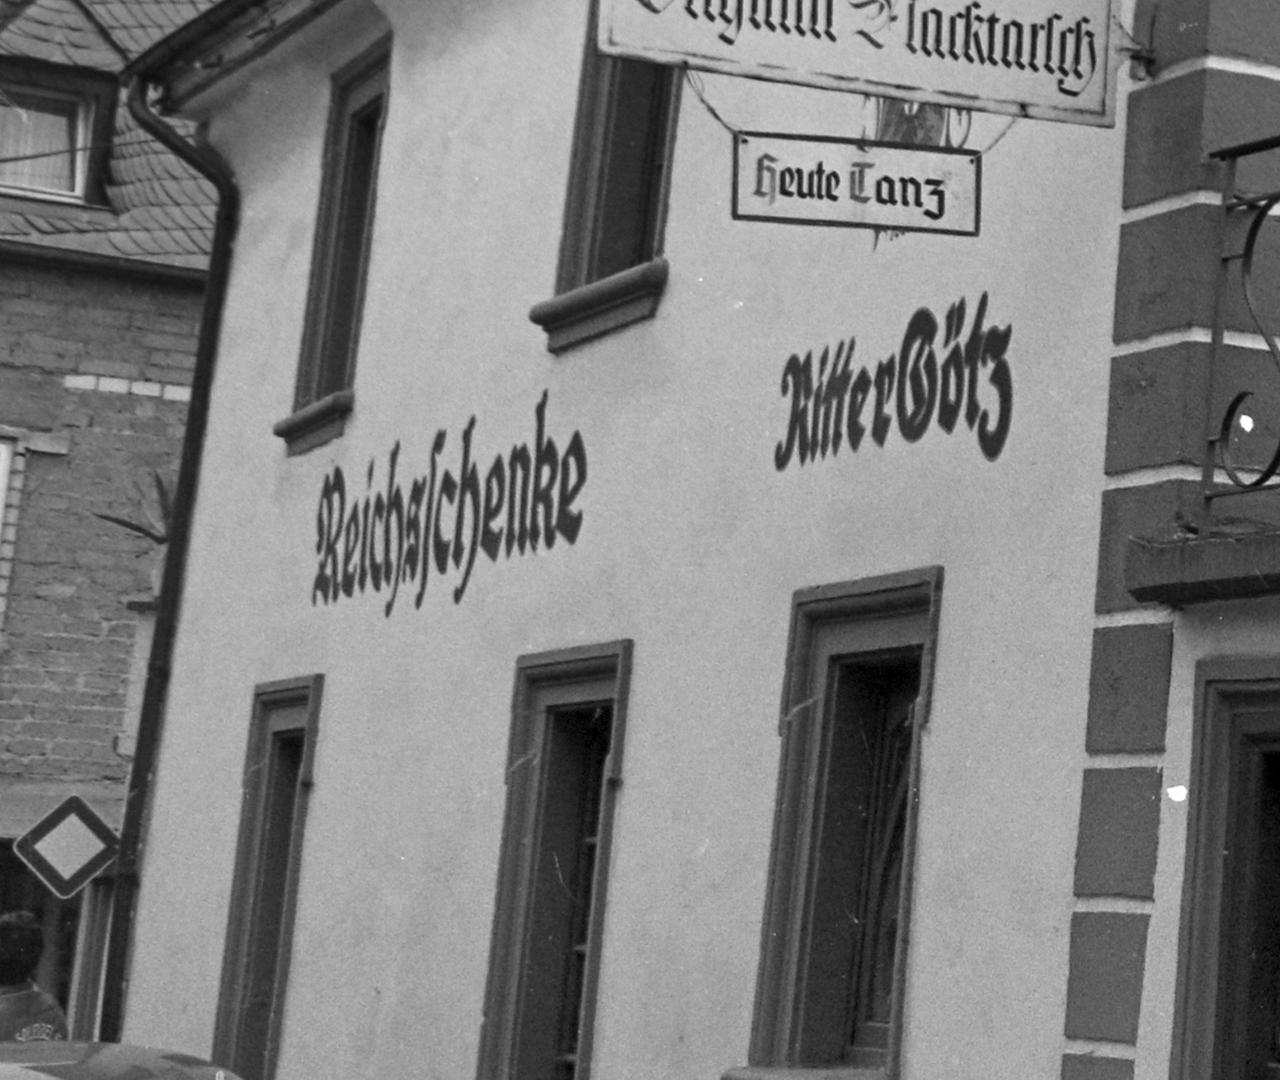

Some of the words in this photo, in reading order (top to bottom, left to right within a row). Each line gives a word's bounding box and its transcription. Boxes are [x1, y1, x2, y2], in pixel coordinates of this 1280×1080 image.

[753, 152, 841, 206] Heute
[849, 161, 946, 221] Tanz
[311, 389, 588, 618] Reichsschenke
